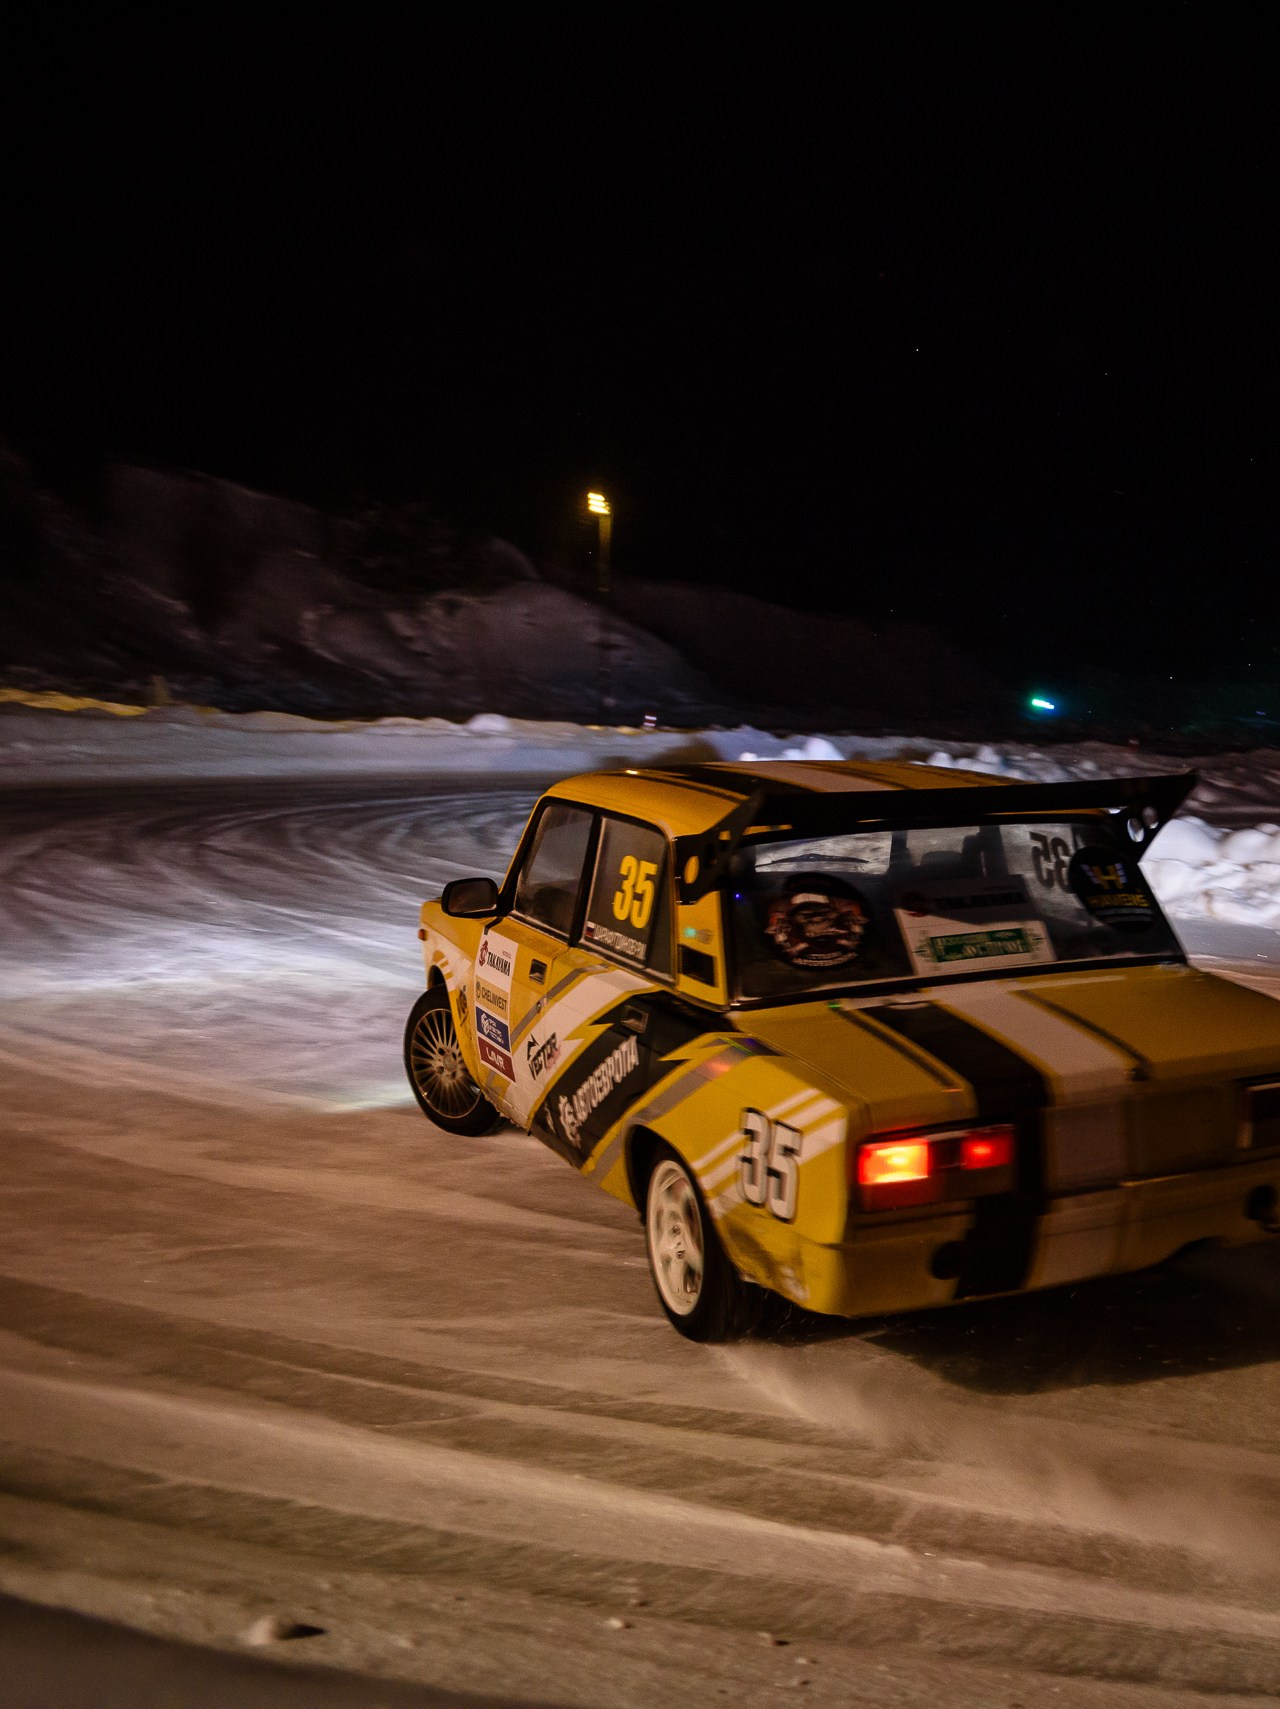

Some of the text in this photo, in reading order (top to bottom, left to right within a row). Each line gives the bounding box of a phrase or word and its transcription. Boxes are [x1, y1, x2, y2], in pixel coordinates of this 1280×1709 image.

[613, 855, 658, 928] 35
[486, 951, 511, 977] TAKAYAMA
[481, 986, 508, 1012] CHELINVEST
[736, 1106, 803, 1224] 35
